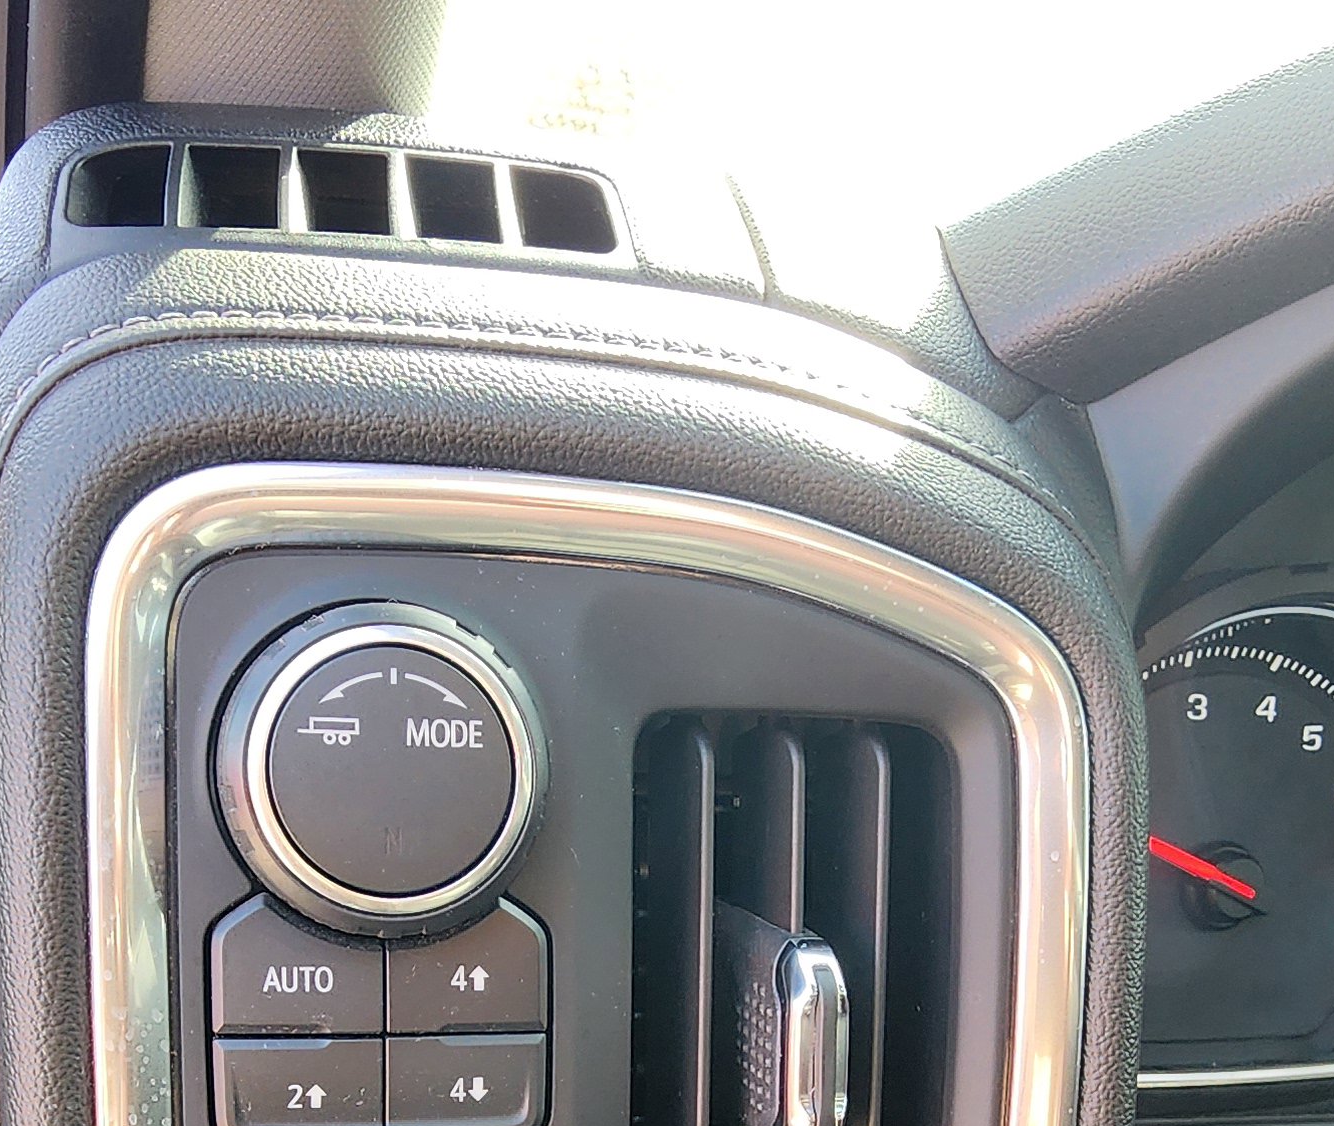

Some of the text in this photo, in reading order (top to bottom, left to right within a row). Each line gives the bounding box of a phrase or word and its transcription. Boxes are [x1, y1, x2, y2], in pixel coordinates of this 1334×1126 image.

[1186, 694, 1208, 721] 3
[1255, 695, 1277, 722] 4
[405, 718, 484, 749] MODE
[1302, 724, 1324, 752] 5
[262, 965, 335, 994] AUTO
